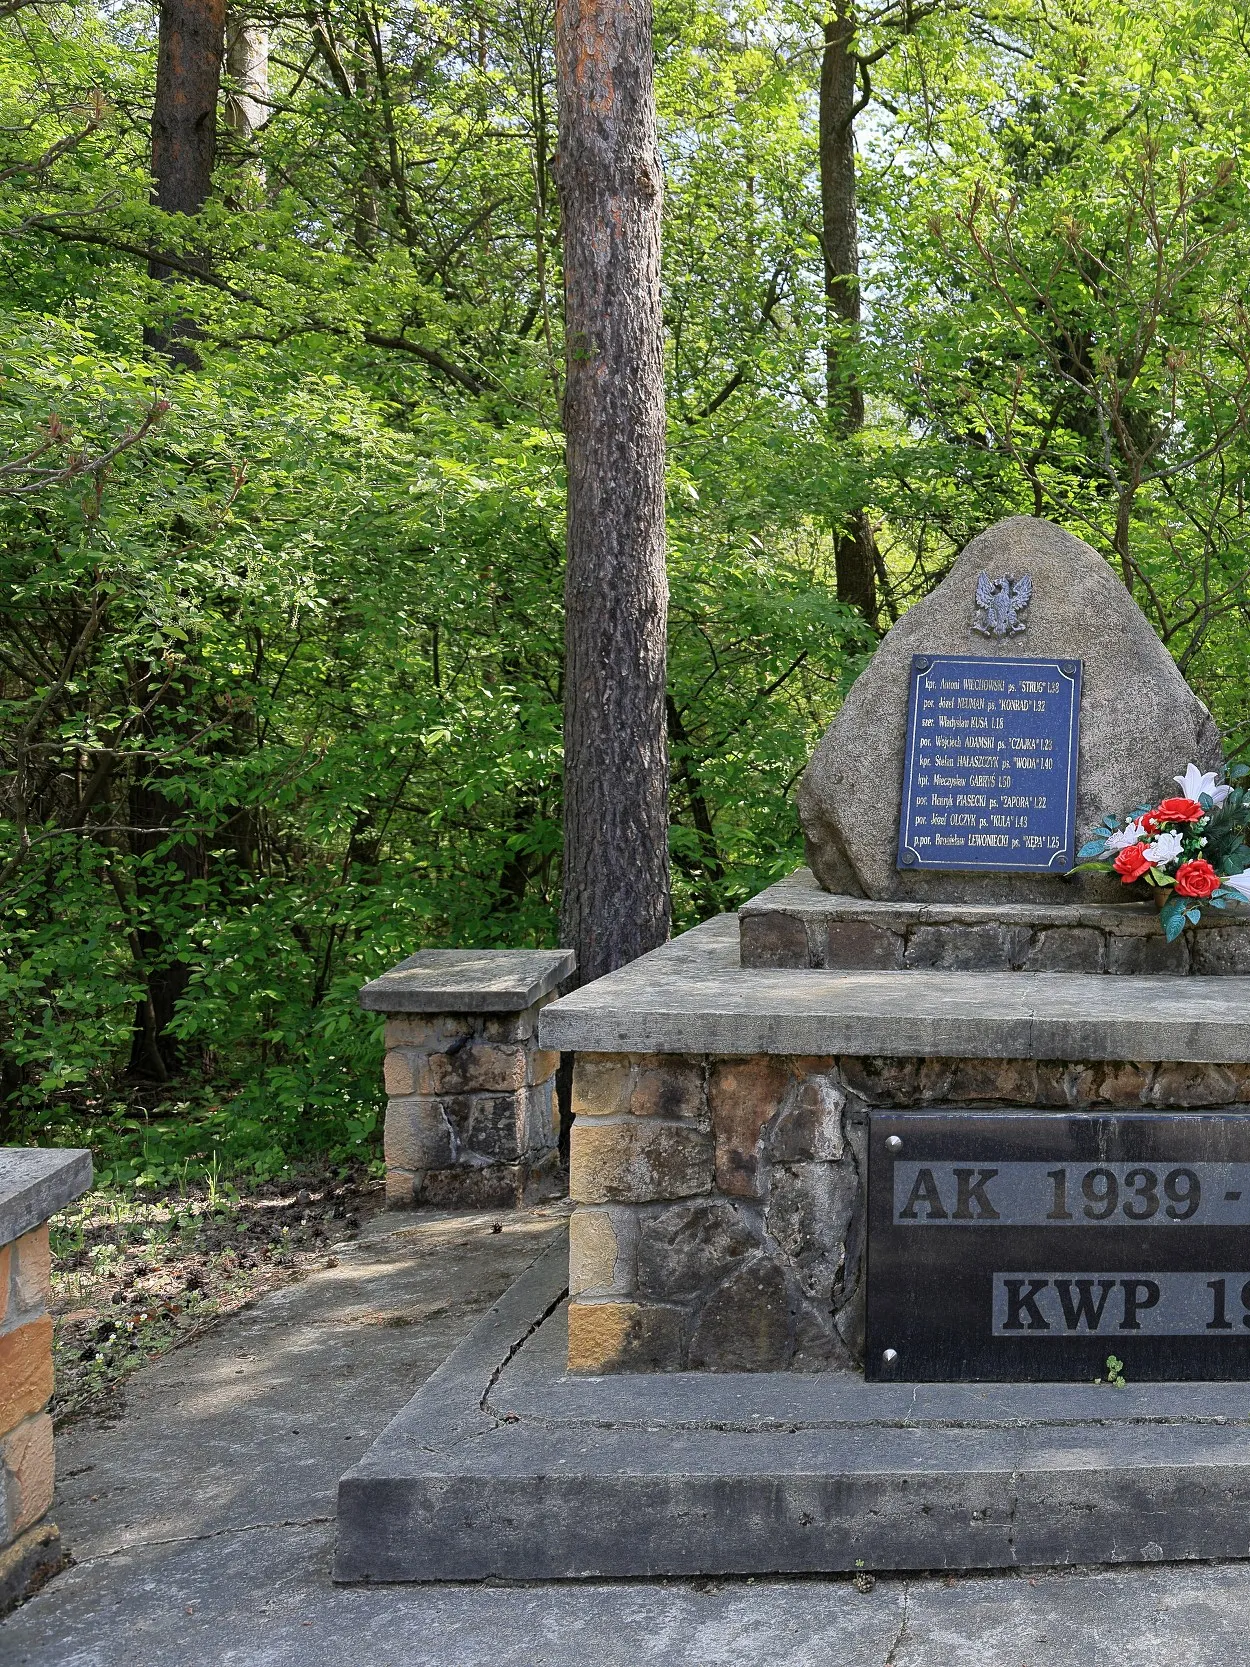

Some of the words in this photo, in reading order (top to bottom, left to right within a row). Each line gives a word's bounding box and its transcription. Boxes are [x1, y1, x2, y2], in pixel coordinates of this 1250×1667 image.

[1008, 684, 1016, 692] ps.
[988, 703, 997, 712] ps.
[997, 741, 1006, 750] ps.
[1002, 760, 1011, 769] ps.
[931, 793, 953, 808] Henryk
[956, 795, 986, 807] PIASECKI
[989, 799, 998, 810] ps.
[979, 818, 988, 829] ps.
[1012, 839, 1021, 849] ps.
[898, 1168, 1001, 1220] AK
[1046, 1168, 1201, 1220] 1939
[1002, 1279, 1161, 1331] KWP
